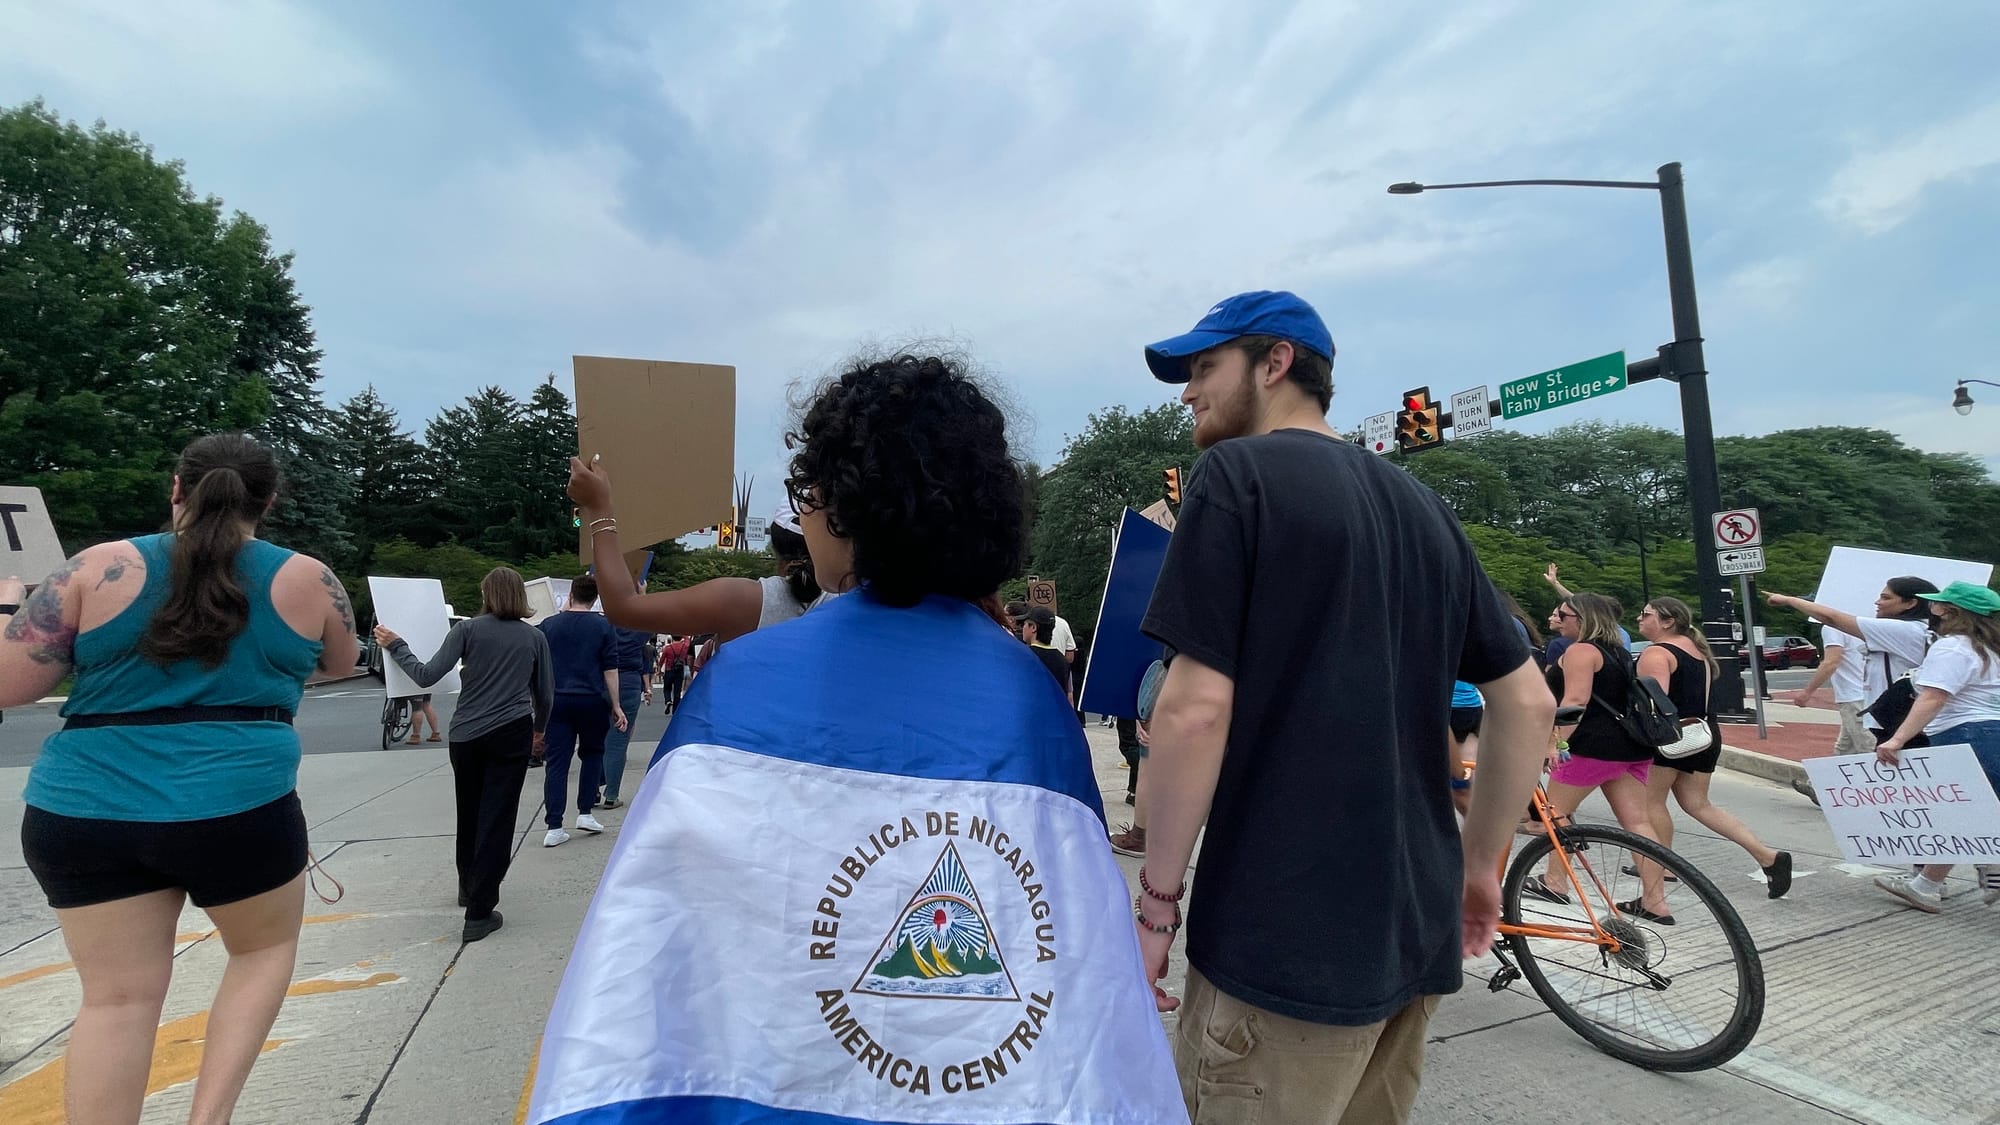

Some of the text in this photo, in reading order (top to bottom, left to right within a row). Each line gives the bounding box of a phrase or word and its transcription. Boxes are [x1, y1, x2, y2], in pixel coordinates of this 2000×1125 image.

[1505, 371, 1562, 398] New St
[1457, 392, 1482, 407] RIGHT
[1507, 380, 1601, 414] Fahy Bridge
[1460, 406, 1482, 419] TURN
[1373, 416, 1385, 425] NO
[1457, 418, 1488, 433] SIGNAL
[1371, 424, 1388, 434] TURN
[1380, 431, 1393, 440] RED
[1741, 552, 1757, 560] USE
[1722, 561, 1761, 571] CROSSWALK
[1838, 756, 1932, 784] FIGHT
[1825, 784, 1971, 808] IGNORANCE
[1879, 808, 1933, 829] NOT
[809, 812, 1056, 963] REPUBLICA DE NICARAGUA
[815, 988, 1054, 1096] AMERICA CENTRAL
